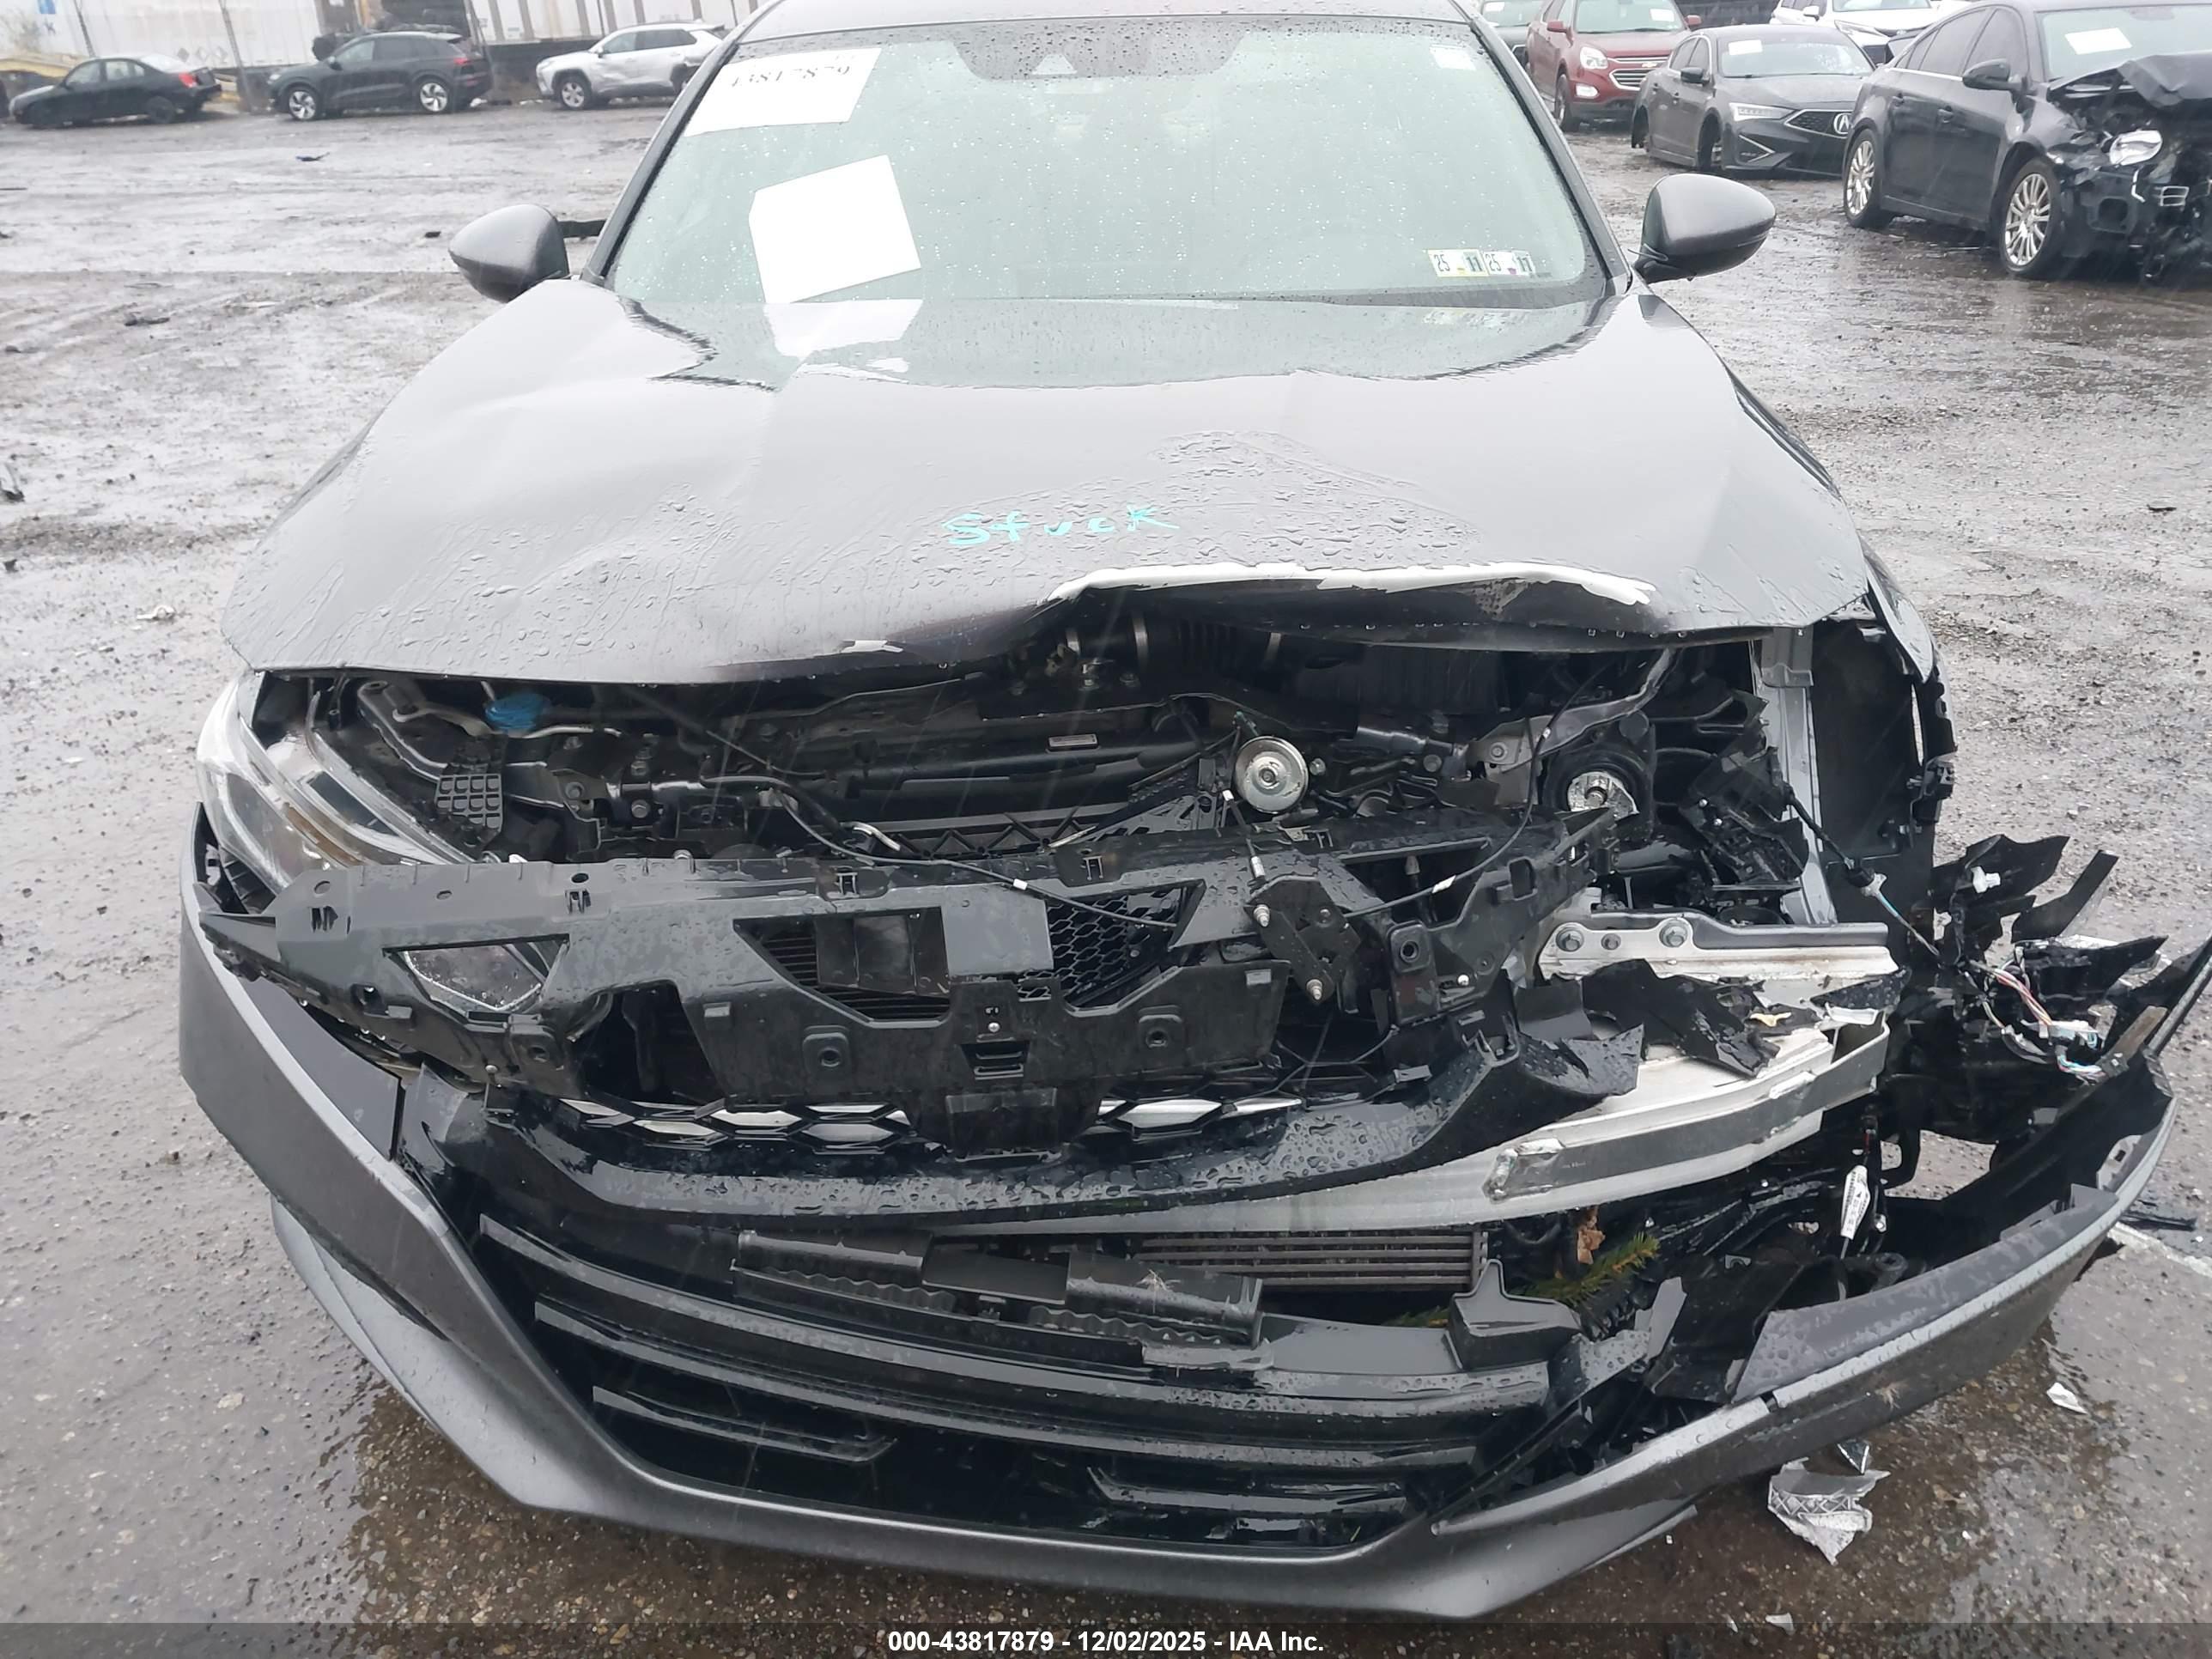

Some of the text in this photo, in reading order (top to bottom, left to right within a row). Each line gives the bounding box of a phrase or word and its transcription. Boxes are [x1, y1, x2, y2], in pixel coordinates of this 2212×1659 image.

[1433, 253, 1484, 272] 25 11
[1485, 252, 1502, 271] 25
